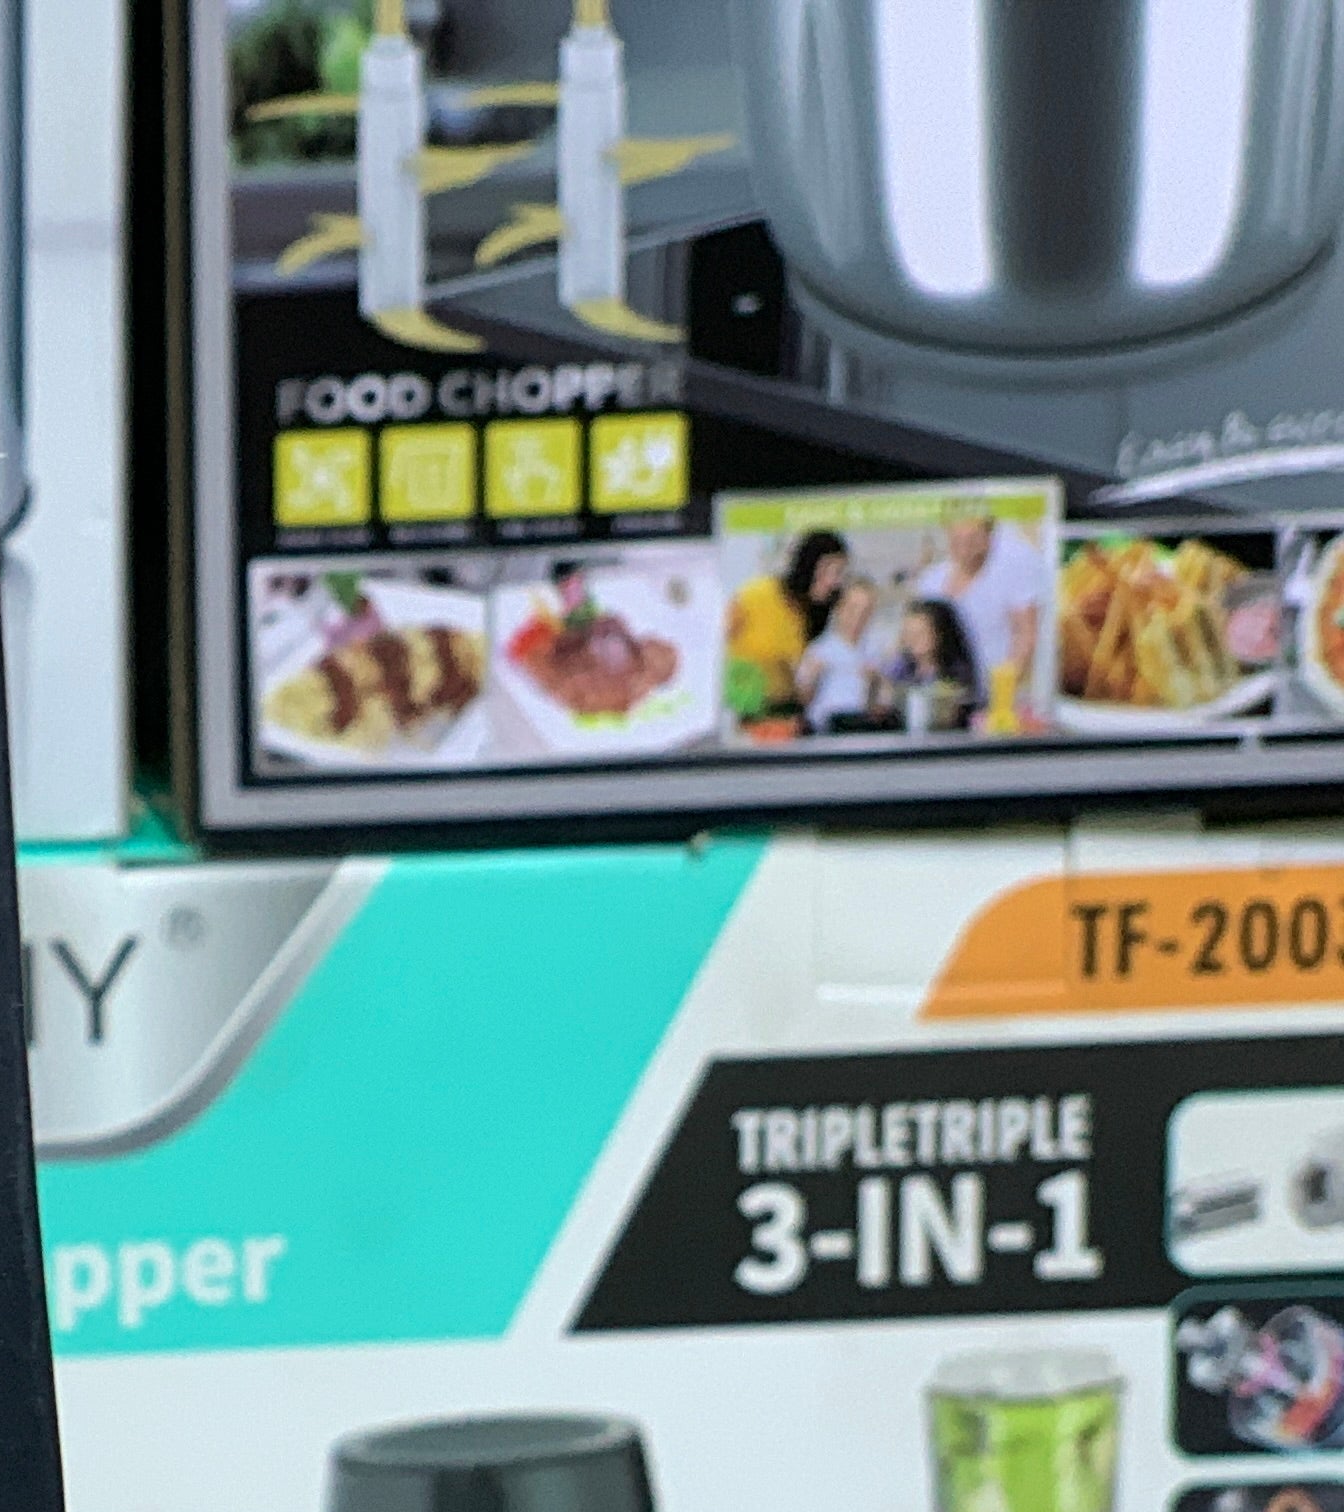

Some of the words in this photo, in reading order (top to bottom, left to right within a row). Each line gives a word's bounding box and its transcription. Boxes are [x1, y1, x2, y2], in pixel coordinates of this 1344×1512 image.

[275, 371, 432, 425] FOOD
[1070, 895, 1344, 982] TF-200
[21, 934, 139, 1046] Y
[731, 1094, 1095, 1175] TRIPLETRIPLE
[733, 1168, 1103, 1295] 3-IN-1
[54, 1232, 287, 1333] pper
